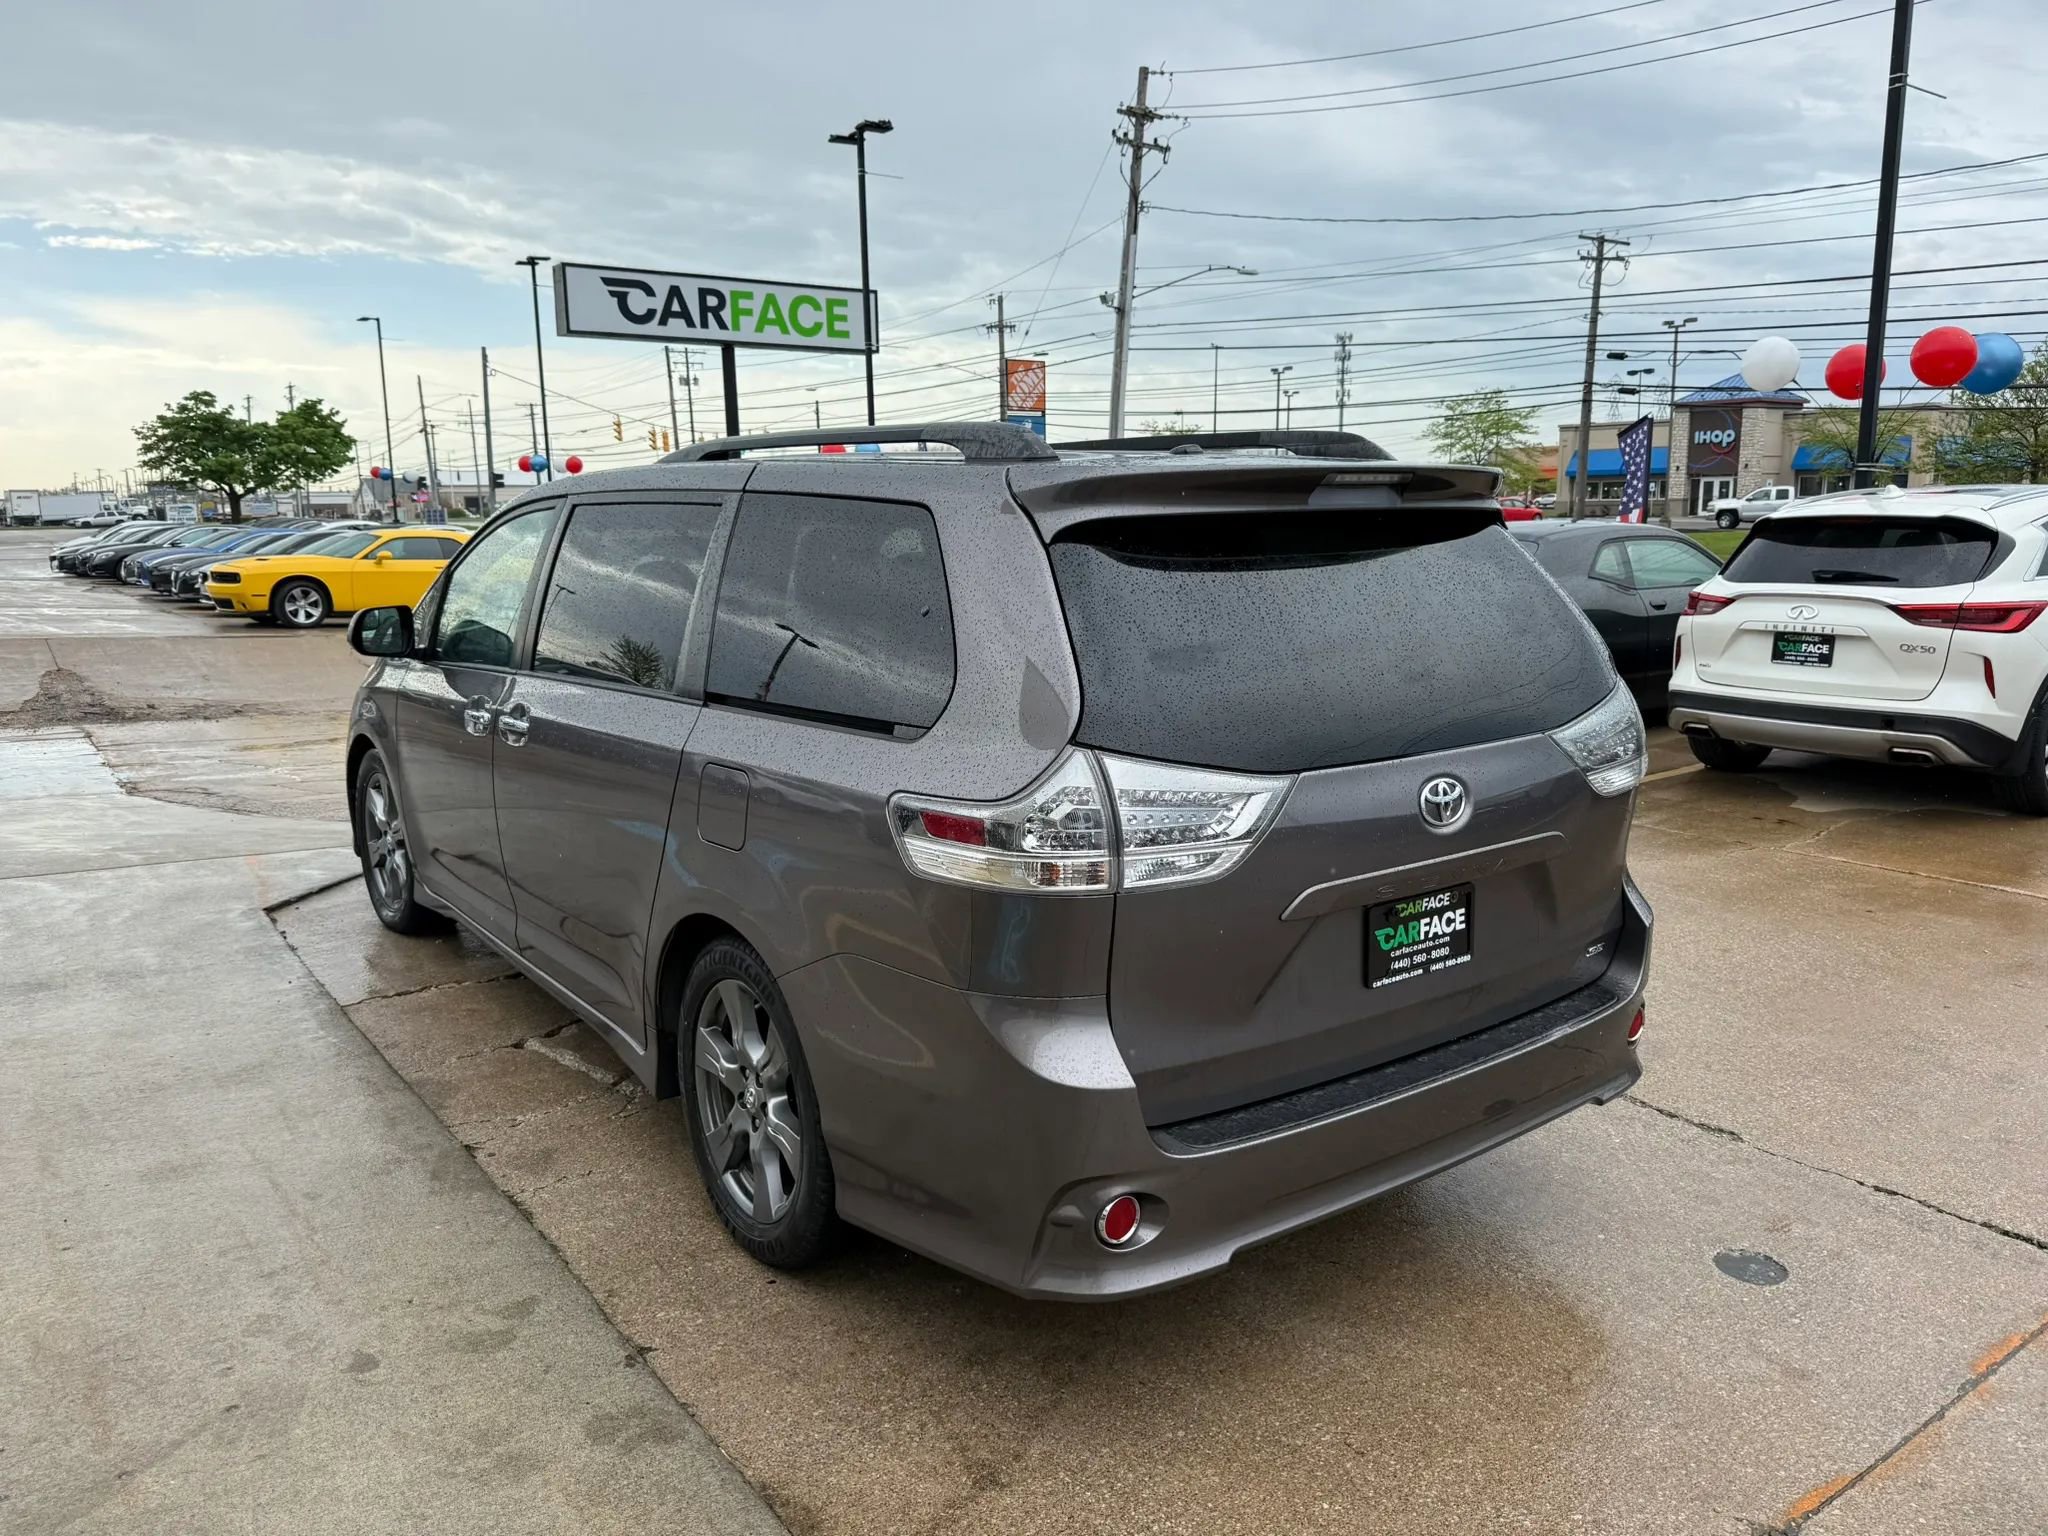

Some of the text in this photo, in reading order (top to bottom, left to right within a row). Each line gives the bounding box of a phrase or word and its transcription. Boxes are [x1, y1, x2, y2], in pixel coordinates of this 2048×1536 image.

[600, 276, 850, 339] CARFACE
[1694, 429, 1735, 447] IHOP
[1765, 624, 1834, 633] INFINITI
[1777, 641, 1830, 654] CARFACE
[1900, 644, 1936, 654] QX50
[1395, 892, 1451, 917] CARFACE
[1375, 908, 1466, 950] CARFACE
[1390, 936, 1450, 957] carfaceauto.com
[1391, 957, 1411, 970] (440)
[1373, 968, 1423, 988] carfaceauto.com
